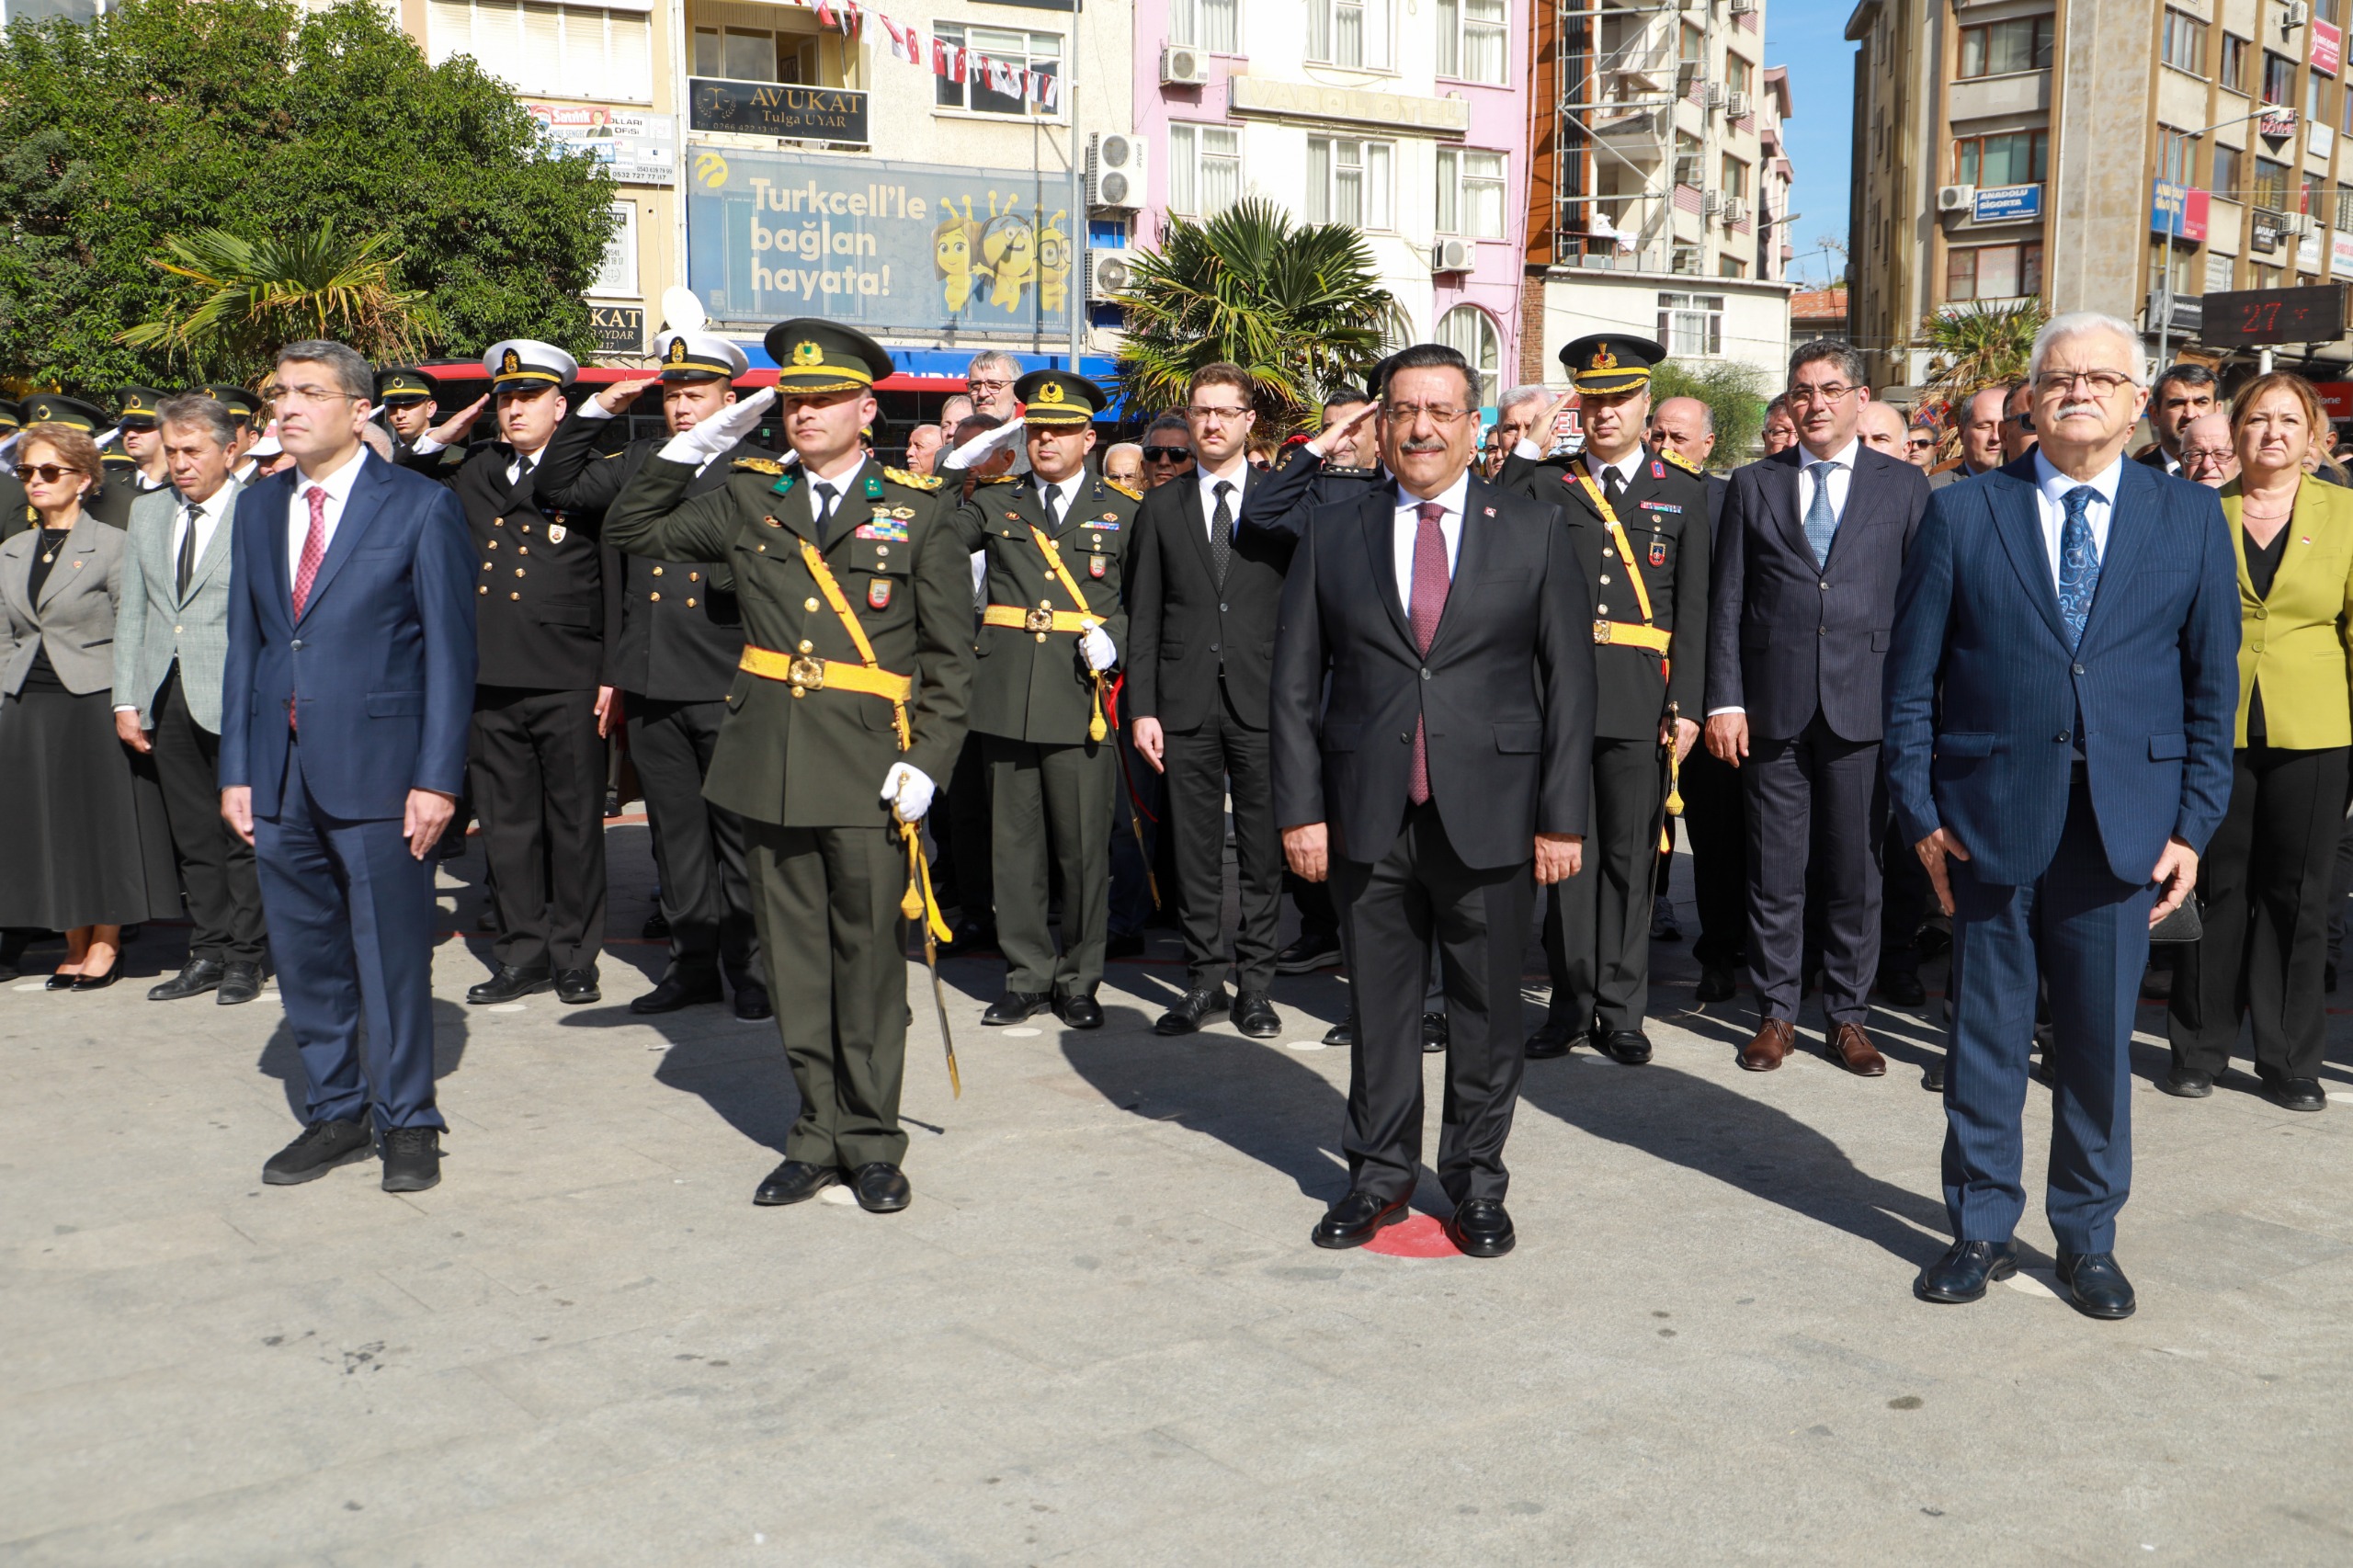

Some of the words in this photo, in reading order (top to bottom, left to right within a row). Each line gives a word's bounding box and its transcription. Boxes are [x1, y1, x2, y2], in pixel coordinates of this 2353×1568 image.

[750, 88, 862, 113] AVUKAT
[1248, 79, 1367, 118] VAROL
[1376, 94, 1463, 126] OTEL
[713, 122, 735, 131] 0266
[739, 124, 756, 132] 422
[762, 109, 801, 127] Tulga
[805, 115, 847, 128] UYAR
[1980, 188, 2028, 199] ANADOLU
[1980, 199, 2022, 210] SİGORTA
[750, 217, 877, 262] bağlan
[751, 258, 891, 301] hayata!
[2242, 301, 2281, 332] 27
